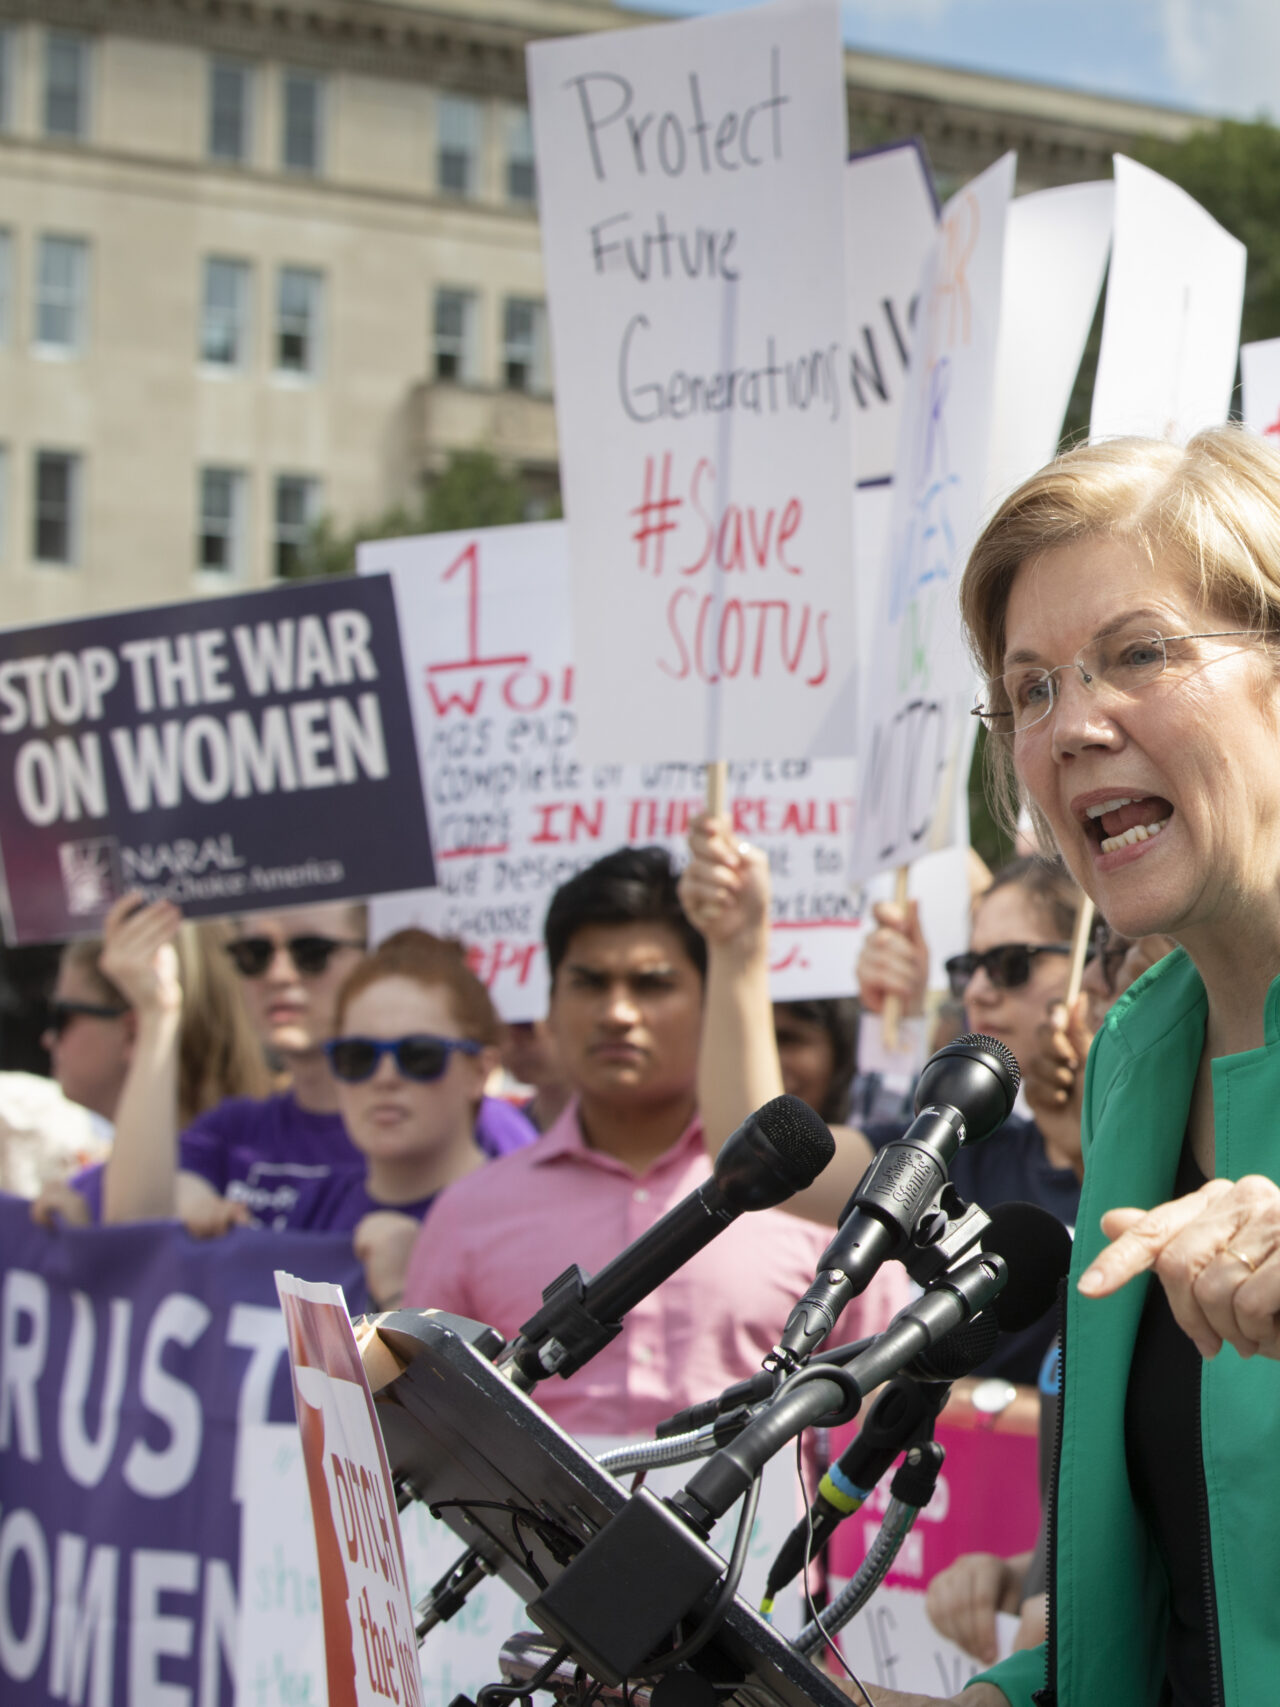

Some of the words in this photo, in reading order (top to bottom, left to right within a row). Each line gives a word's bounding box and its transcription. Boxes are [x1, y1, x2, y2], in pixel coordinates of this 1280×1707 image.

[562, 45, 790, 181] Protect
[588, 211, 740, 282] Future
[629, 451, 803, 578] #Save
[0, 646, 119, 734] STOP
[120, 628, 236, 713] THE
[233, 609, 379, 698] WAR
[657, 586, 831, 687] SCOTUS
[14, 731, 108, 827] ON
[109, 692, 391, 814] WOMEN
[121, 832, 246, 880] NARAL
[529, 798, 605, 844] IN
[331, 1452, 400, 1592] DITCH
[359, 1586, 399, 1706] the
